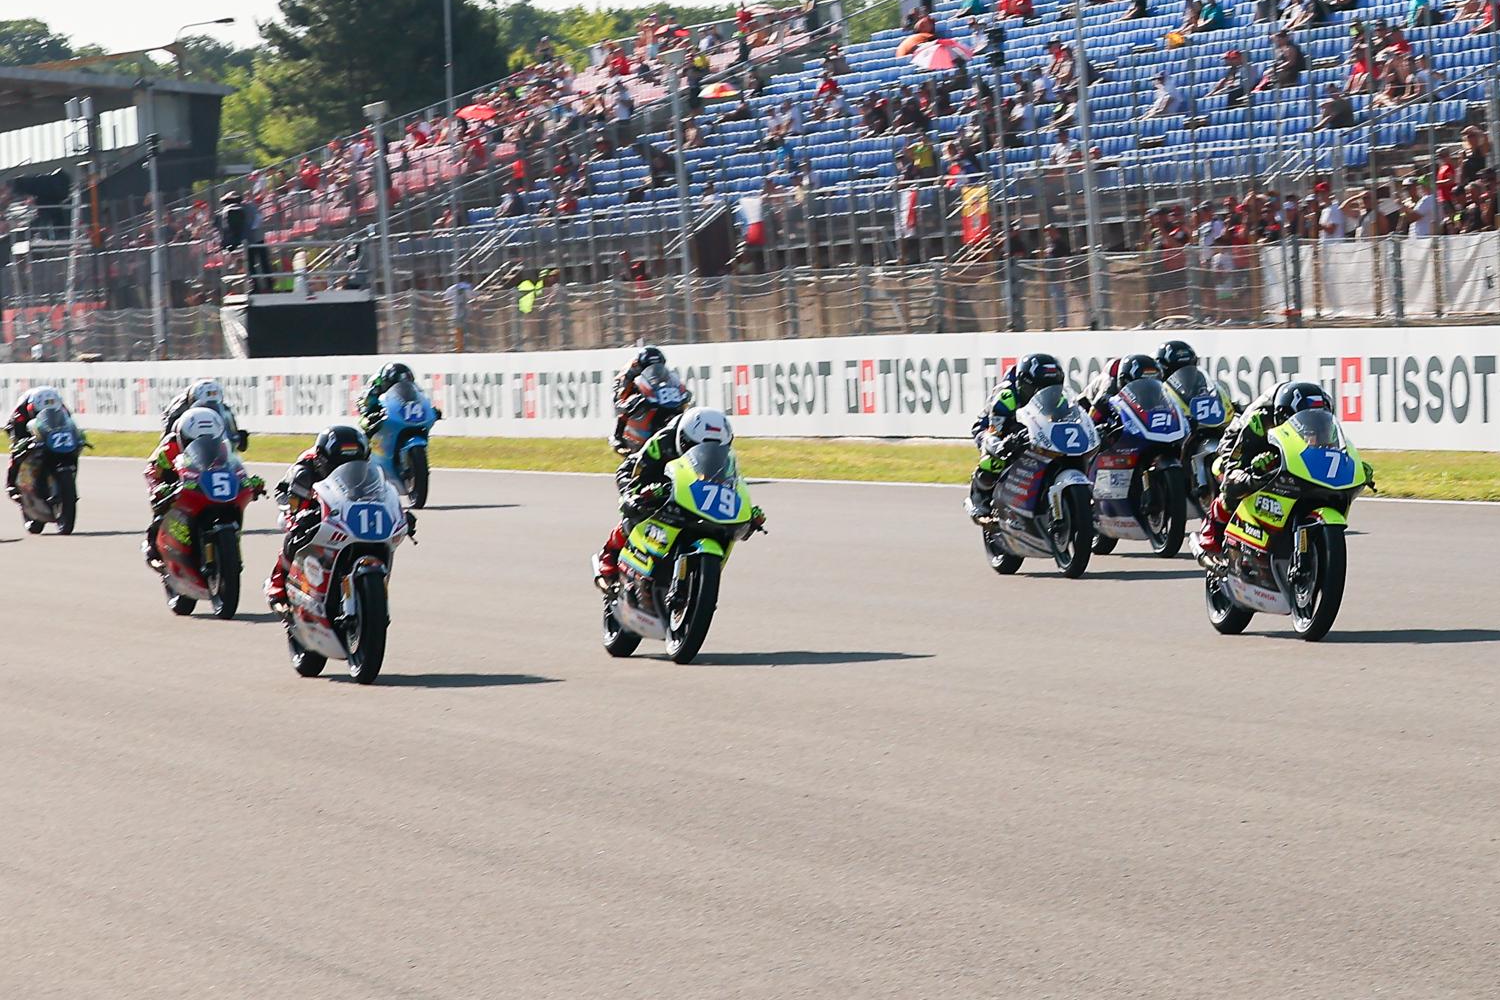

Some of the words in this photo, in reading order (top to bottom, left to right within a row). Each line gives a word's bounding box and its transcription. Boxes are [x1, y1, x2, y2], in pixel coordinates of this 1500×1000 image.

[754, 361, 832, 415] TISSOT
[879, 358, 968, 414] TISSOT
[1369, 355, 1496, 424] TISSOT
[404, 401, 424, 420] 14
[1151, 413, 1173, 428] 21
[1196, 400, 1222, 420] 54
[1064, 427, 1080, 448] 2
[1325, 451, 1341, 479] 7
[211, 472, 231, 497] 5
[700, 485, 736, 517] 79
[357, 509, 384, 535] 11
